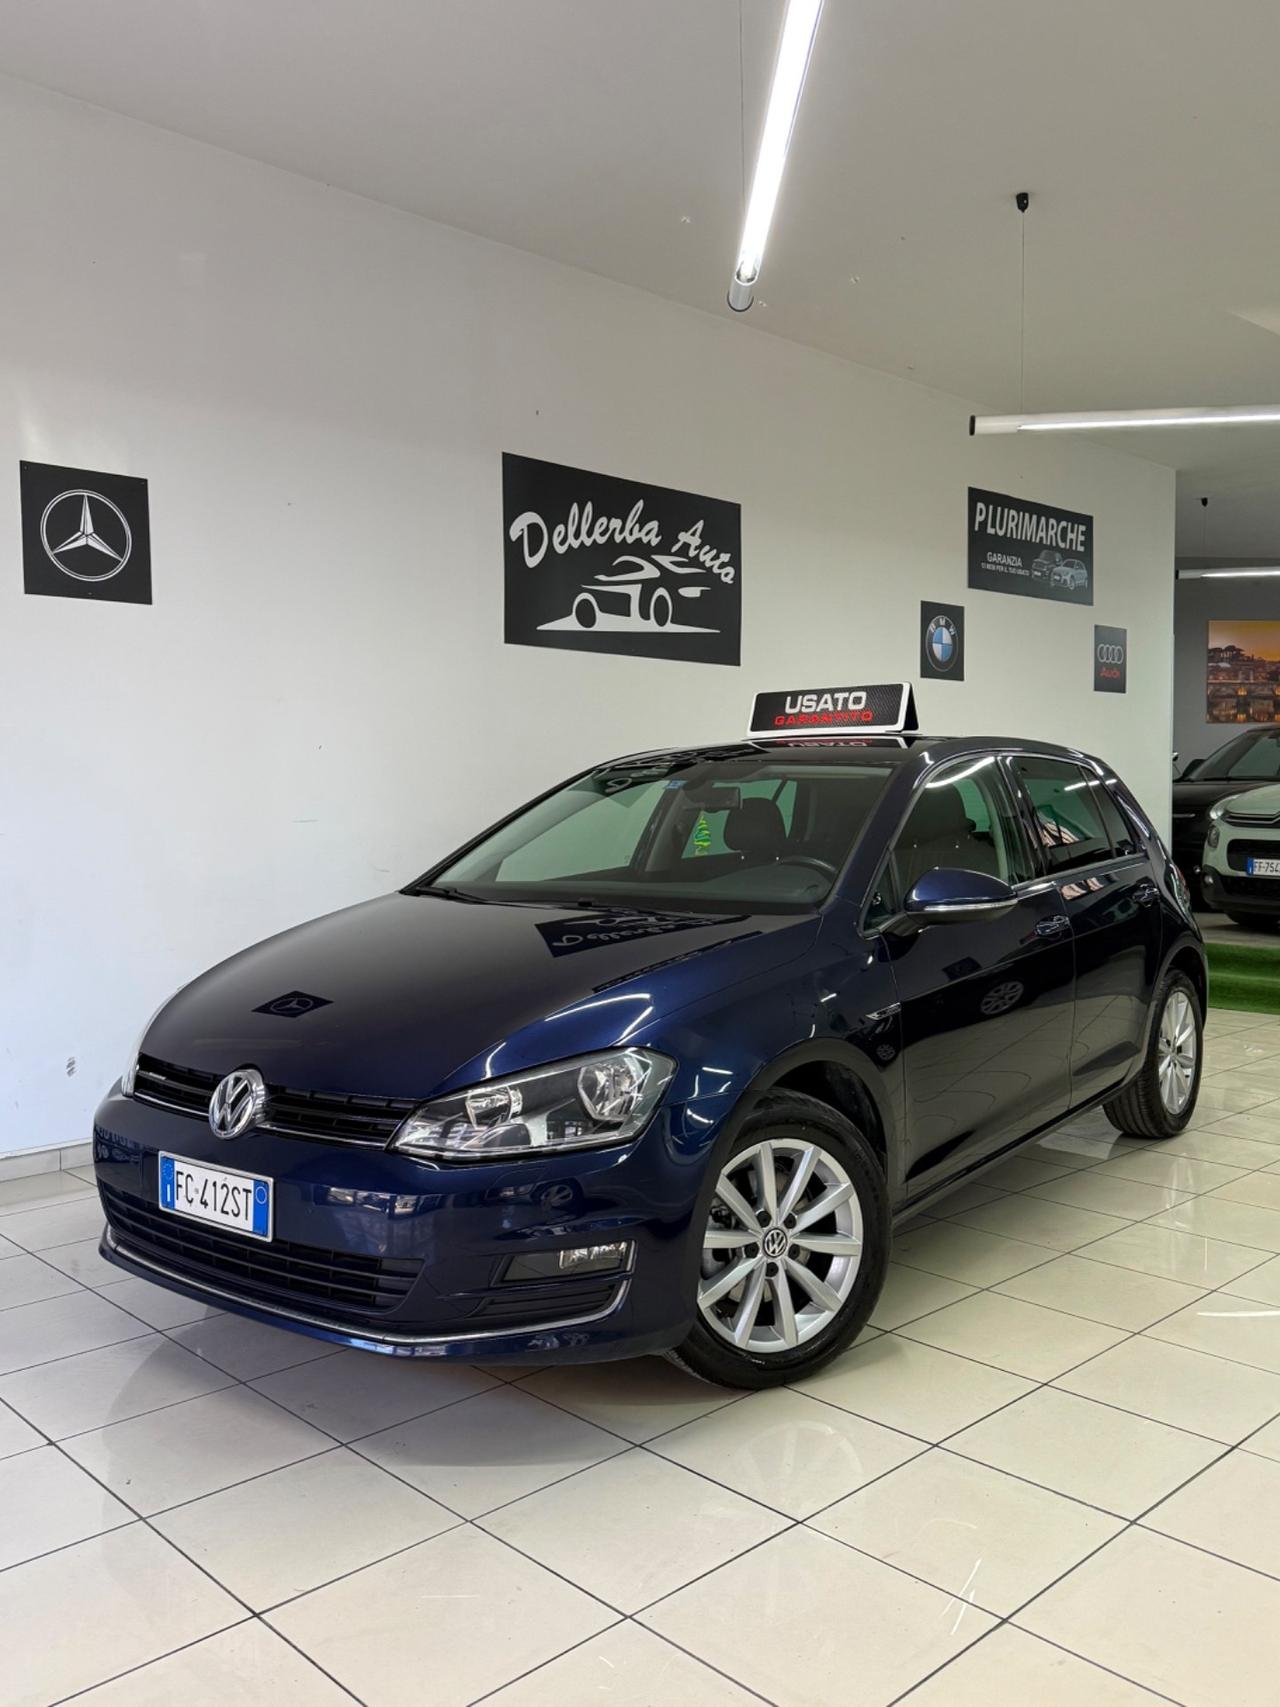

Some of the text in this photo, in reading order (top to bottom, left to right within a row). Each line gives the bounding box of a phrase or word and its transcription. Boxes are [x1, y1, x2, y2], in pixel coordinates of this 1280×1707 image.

[974, 501, 1087, 552] PLURIMARCHE
[509, 499, 736, 584] Dellerba Auto
[987, 551, 1023, 567] GARANZIA
[1100, 667, 1121, 679] Audi
[785, 691, 867, 714] USATO
[774, 710, 873, 726] GARANTITO
